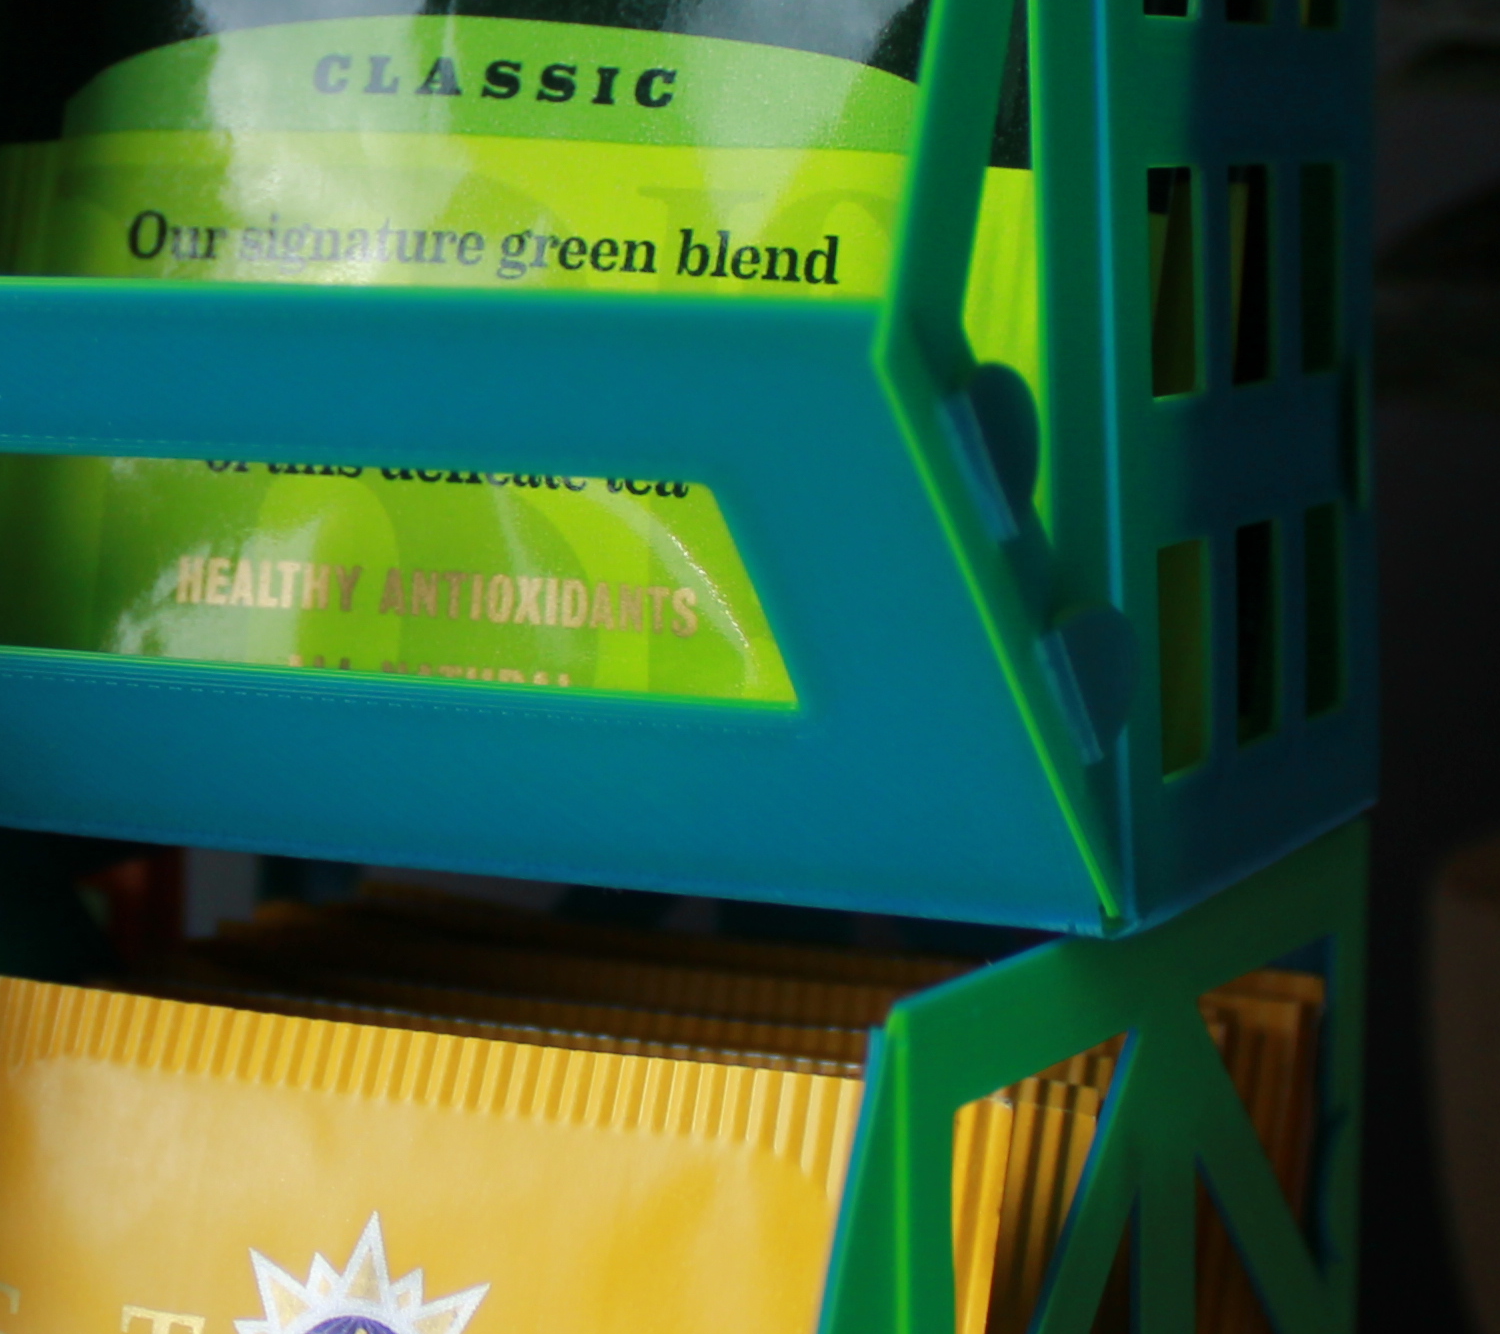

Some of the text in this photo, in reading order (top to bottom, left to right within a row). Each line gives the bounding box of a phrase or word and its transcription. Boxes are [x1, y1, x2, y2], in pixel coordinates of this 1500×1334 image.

[312, 53, 680, 109] CLASSIC
[127, 210, 841, 286] Our signature green blend
[174, 554, 699, 639] HEALTHY ANTIOXIDANTS
